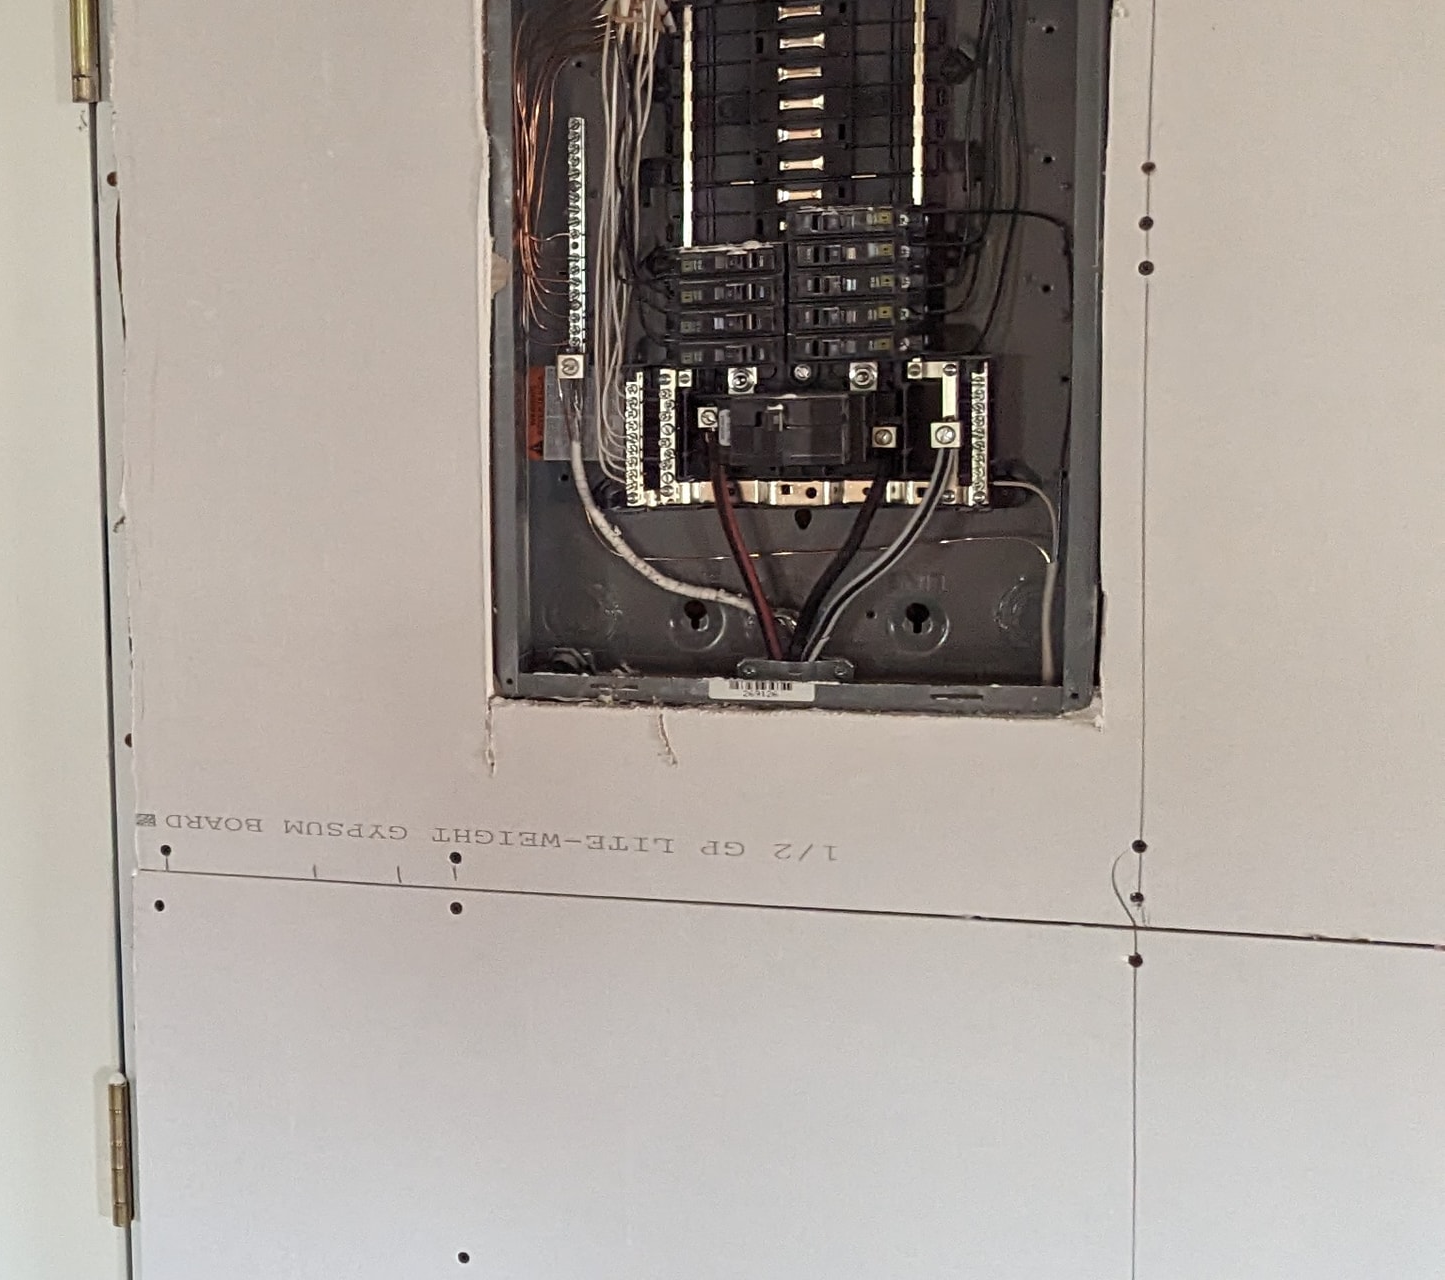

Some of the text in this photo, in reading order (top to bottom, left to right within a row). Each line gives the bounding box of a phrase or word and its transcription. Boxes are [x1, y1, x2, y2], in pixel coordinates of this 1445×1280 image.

[165, 813, 839, 861] 1/2 GP LITE-WEIGHT GYPSUM BOARD
